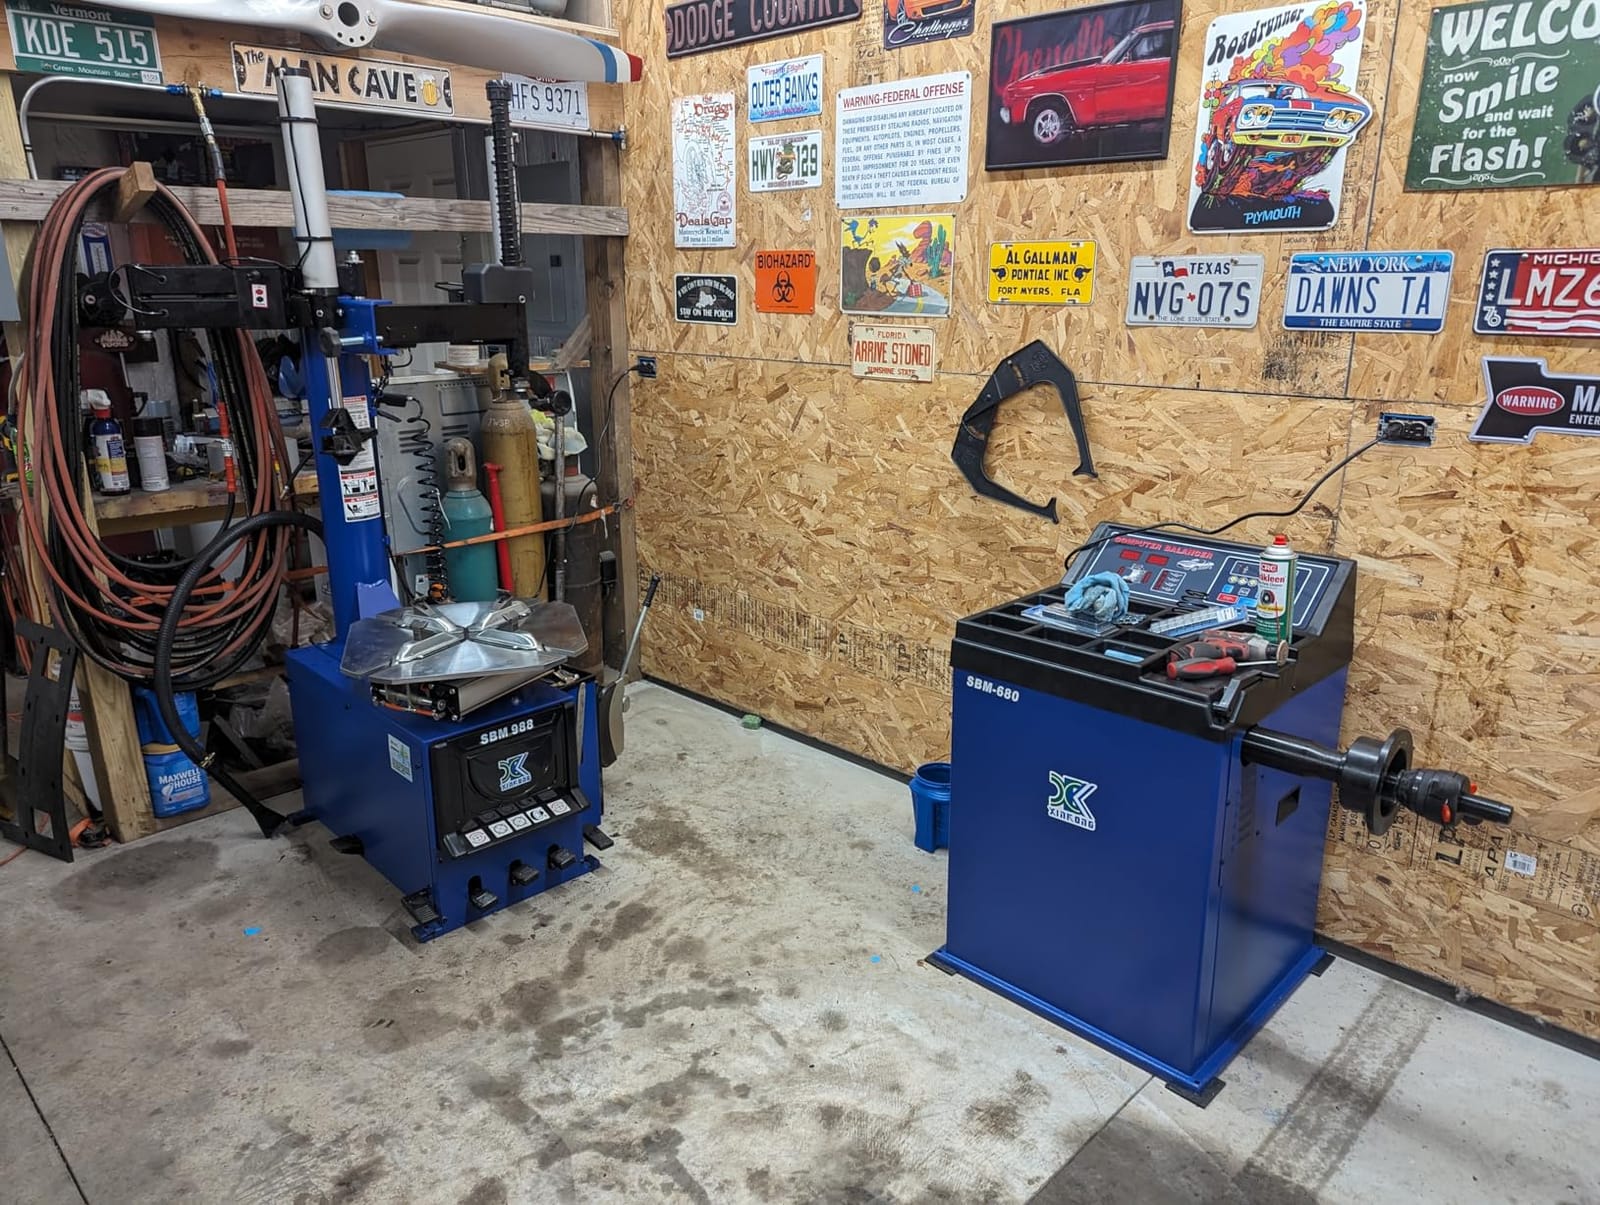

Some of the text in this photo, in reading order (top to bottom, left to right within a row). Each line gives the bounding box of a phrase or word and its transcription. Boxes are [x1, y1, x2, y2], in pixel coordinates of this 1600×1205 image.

[51, 3, 112, 22] Vermont
[674, 0, 735, 49] DODGE
[888, 18, 968, 44] Challenger
[1441, 0, 1600, 56] WELCO
[22, 16, 149, 65] KDE 515
[1208, 8, 1304, 65] Roadrunner
[244, 49, 265, 65] The
[53, 64, 74, 72] Green
[78, 67, 111, 76] Mountain
[1444, 70, 1479, 84] now
[348, 65, 417, 103] CAVE
[752, 72, 818, 109] OUTER BANKS
[1439, 62, 1559, 123] Smile
[511, 82, 582, 116] HFS 9371
[843, 81, 965, 108] WARNING-FEDERAL OFFENSE
[694, 102, 733, 120] Dragon
[932, 105, 954, 114] LOCATED
[1484, 105, 1554, 123] and wait
[1462, 126, 1517, 140] for the
[752, 143, 818, 182] HWY 129
[1430, 137, 1547, 174] Flash!
[676, 211, 732, 229] Deals Gap
[1244, 206, 1301, 225] PLYMOUTH
[758, 254, 811, 269] BIOHAZARD
[1006, 250, 1077, 264] AL GALLMAN
[1327, 256, 1411, 273] NEW YORK
[1533, 254, 1600, 265] MICHIG
[1012, 268, 1050, 280] PONTIAC
[1190, 262, 1230, 275] TEXAS
[998, 286, 1018, 294] FORT
[1296, 276, 1431, 315] DAWNS TA
[1497, 268, 1600, 307] LMZ6
[1134, 282, 1185, 316] NVG
[680, 308, 734, 318] STAY ON THE PORCH
[1482, 305, 1501, 327] 76
[1320, 318, 1402, 328] THE EMPIRE STATE
[878, 330, 906, 340] FLORIDA
[855, 340, 931, 367] ARRIVE STONED
[868, 366, 916, 376] SUNSHINE STATE
[1502, 394, 1557, 410] WARNING
[1114, 536, 1214, 559] COMPUTER BALANCER
[966, 675, 1020, 702] SBM-680
[480, 719, 534, 745] SBM 988
[159, 767, 201, 784] MAXWELL
[174, 775, 202, 789] HOUSE
[1484, 836, 1504, 880] APA
